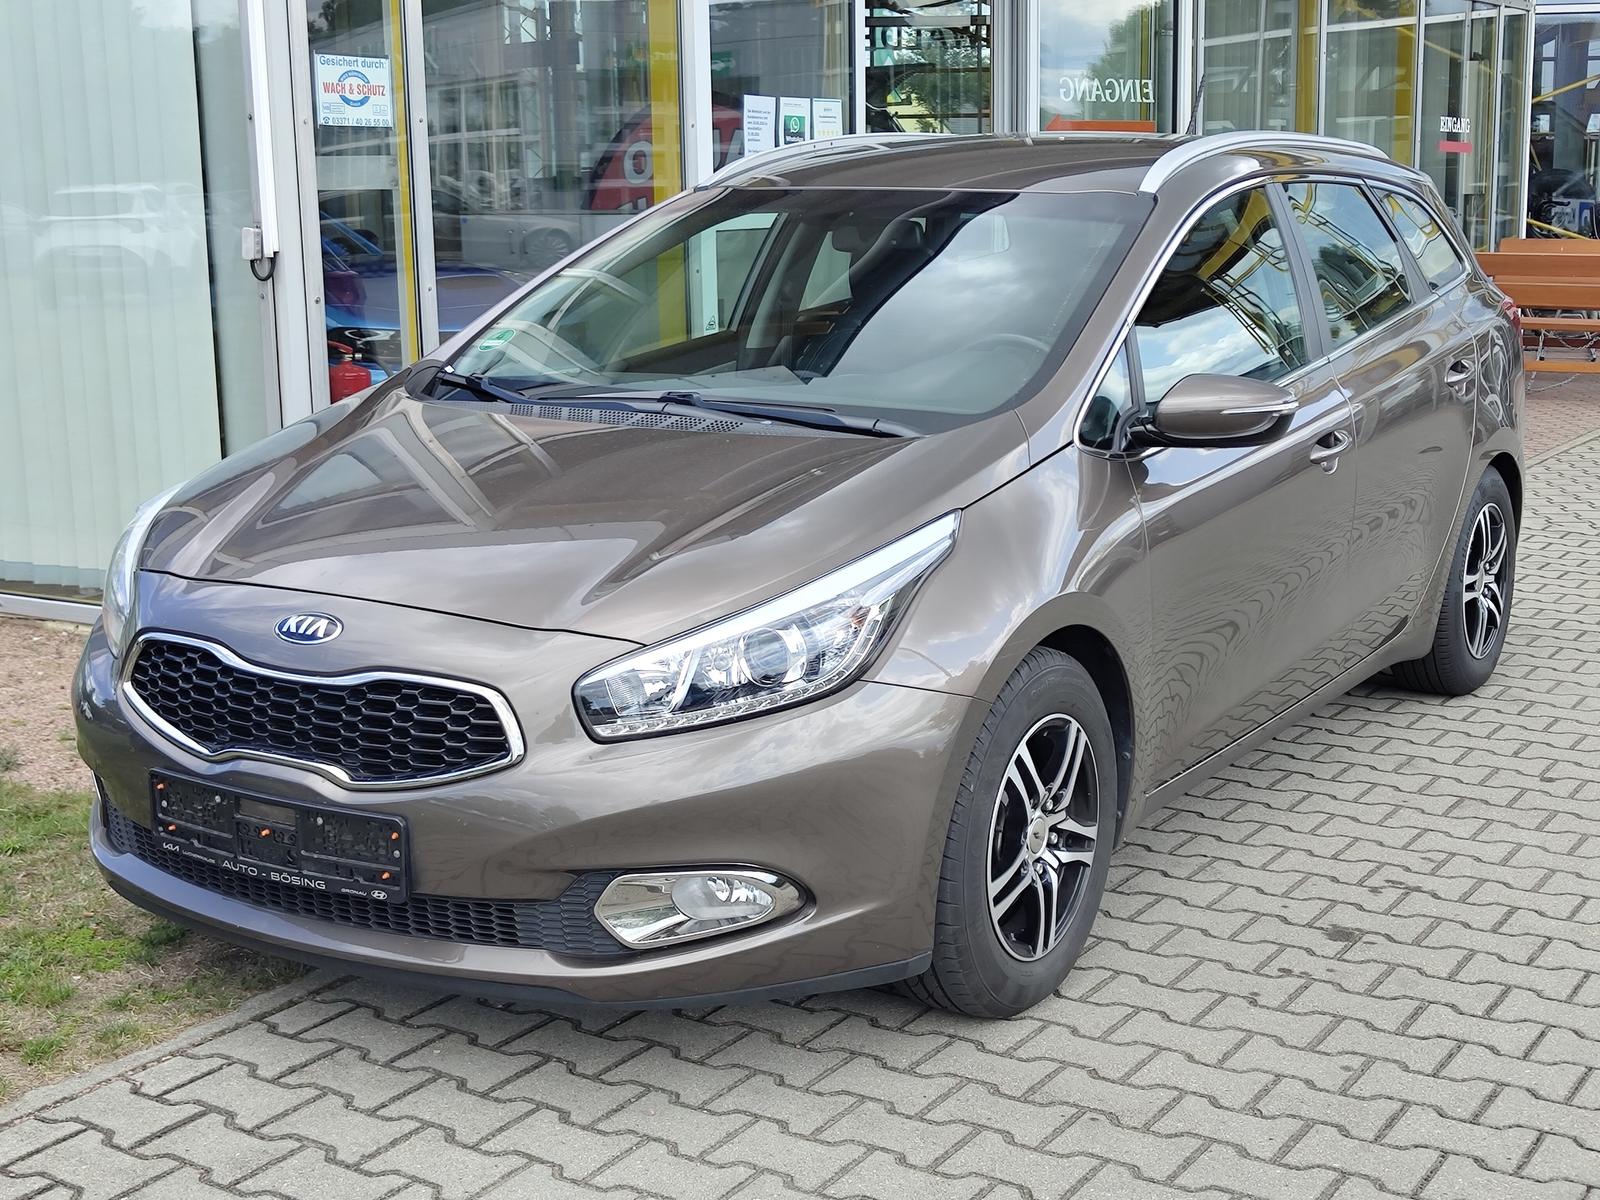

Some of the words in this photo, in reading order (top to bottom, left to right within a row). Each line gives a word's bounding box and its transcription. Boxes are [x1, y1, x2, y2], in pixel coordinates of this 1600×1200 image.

[320, 55, 359, 67] Gesichert
[323, 81, 346, 94] WACH
[349, 83, 354, 95] &
[357, 84, 385, 96] SCHUTZ
[332, 117, 350, 125] 03371
[1440, 116, 1471, 133] EINGANG
[282, 615, 330, 638] KIA
[222, 860, 258, 876] AUTO
[270, 871, 326, 890] BÖSING
